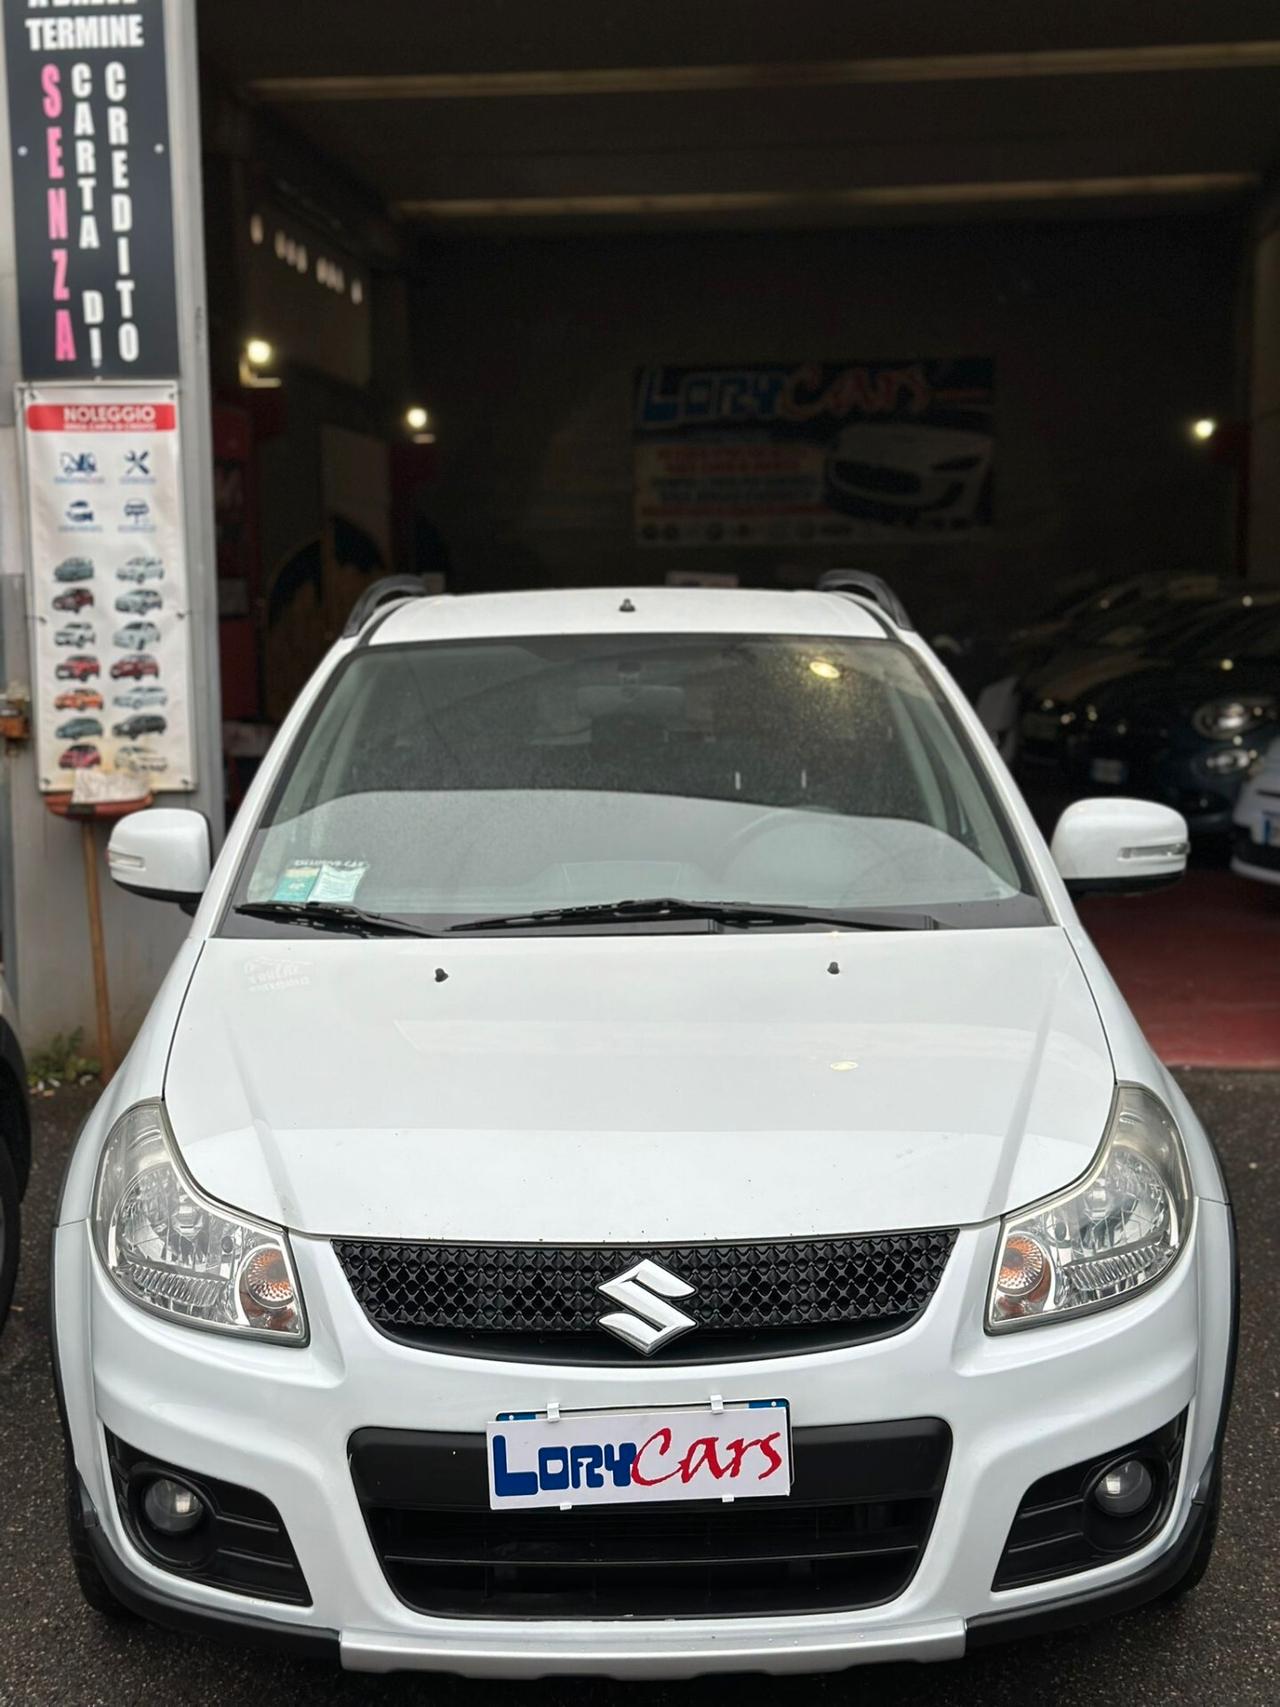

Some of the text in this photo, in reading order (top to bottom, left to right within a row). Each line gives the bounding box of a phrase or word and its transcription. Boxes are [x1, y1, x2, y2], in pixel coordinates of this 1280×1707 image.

[25, 14, 145, 50] TERMINE
[41, 63, 77, 361] SENZA
[71, 62, 104, 367] CARTA DI
[104, 61, 139, 362] CREDITO
[63, 406, 156, 422] NOLEGGIO
